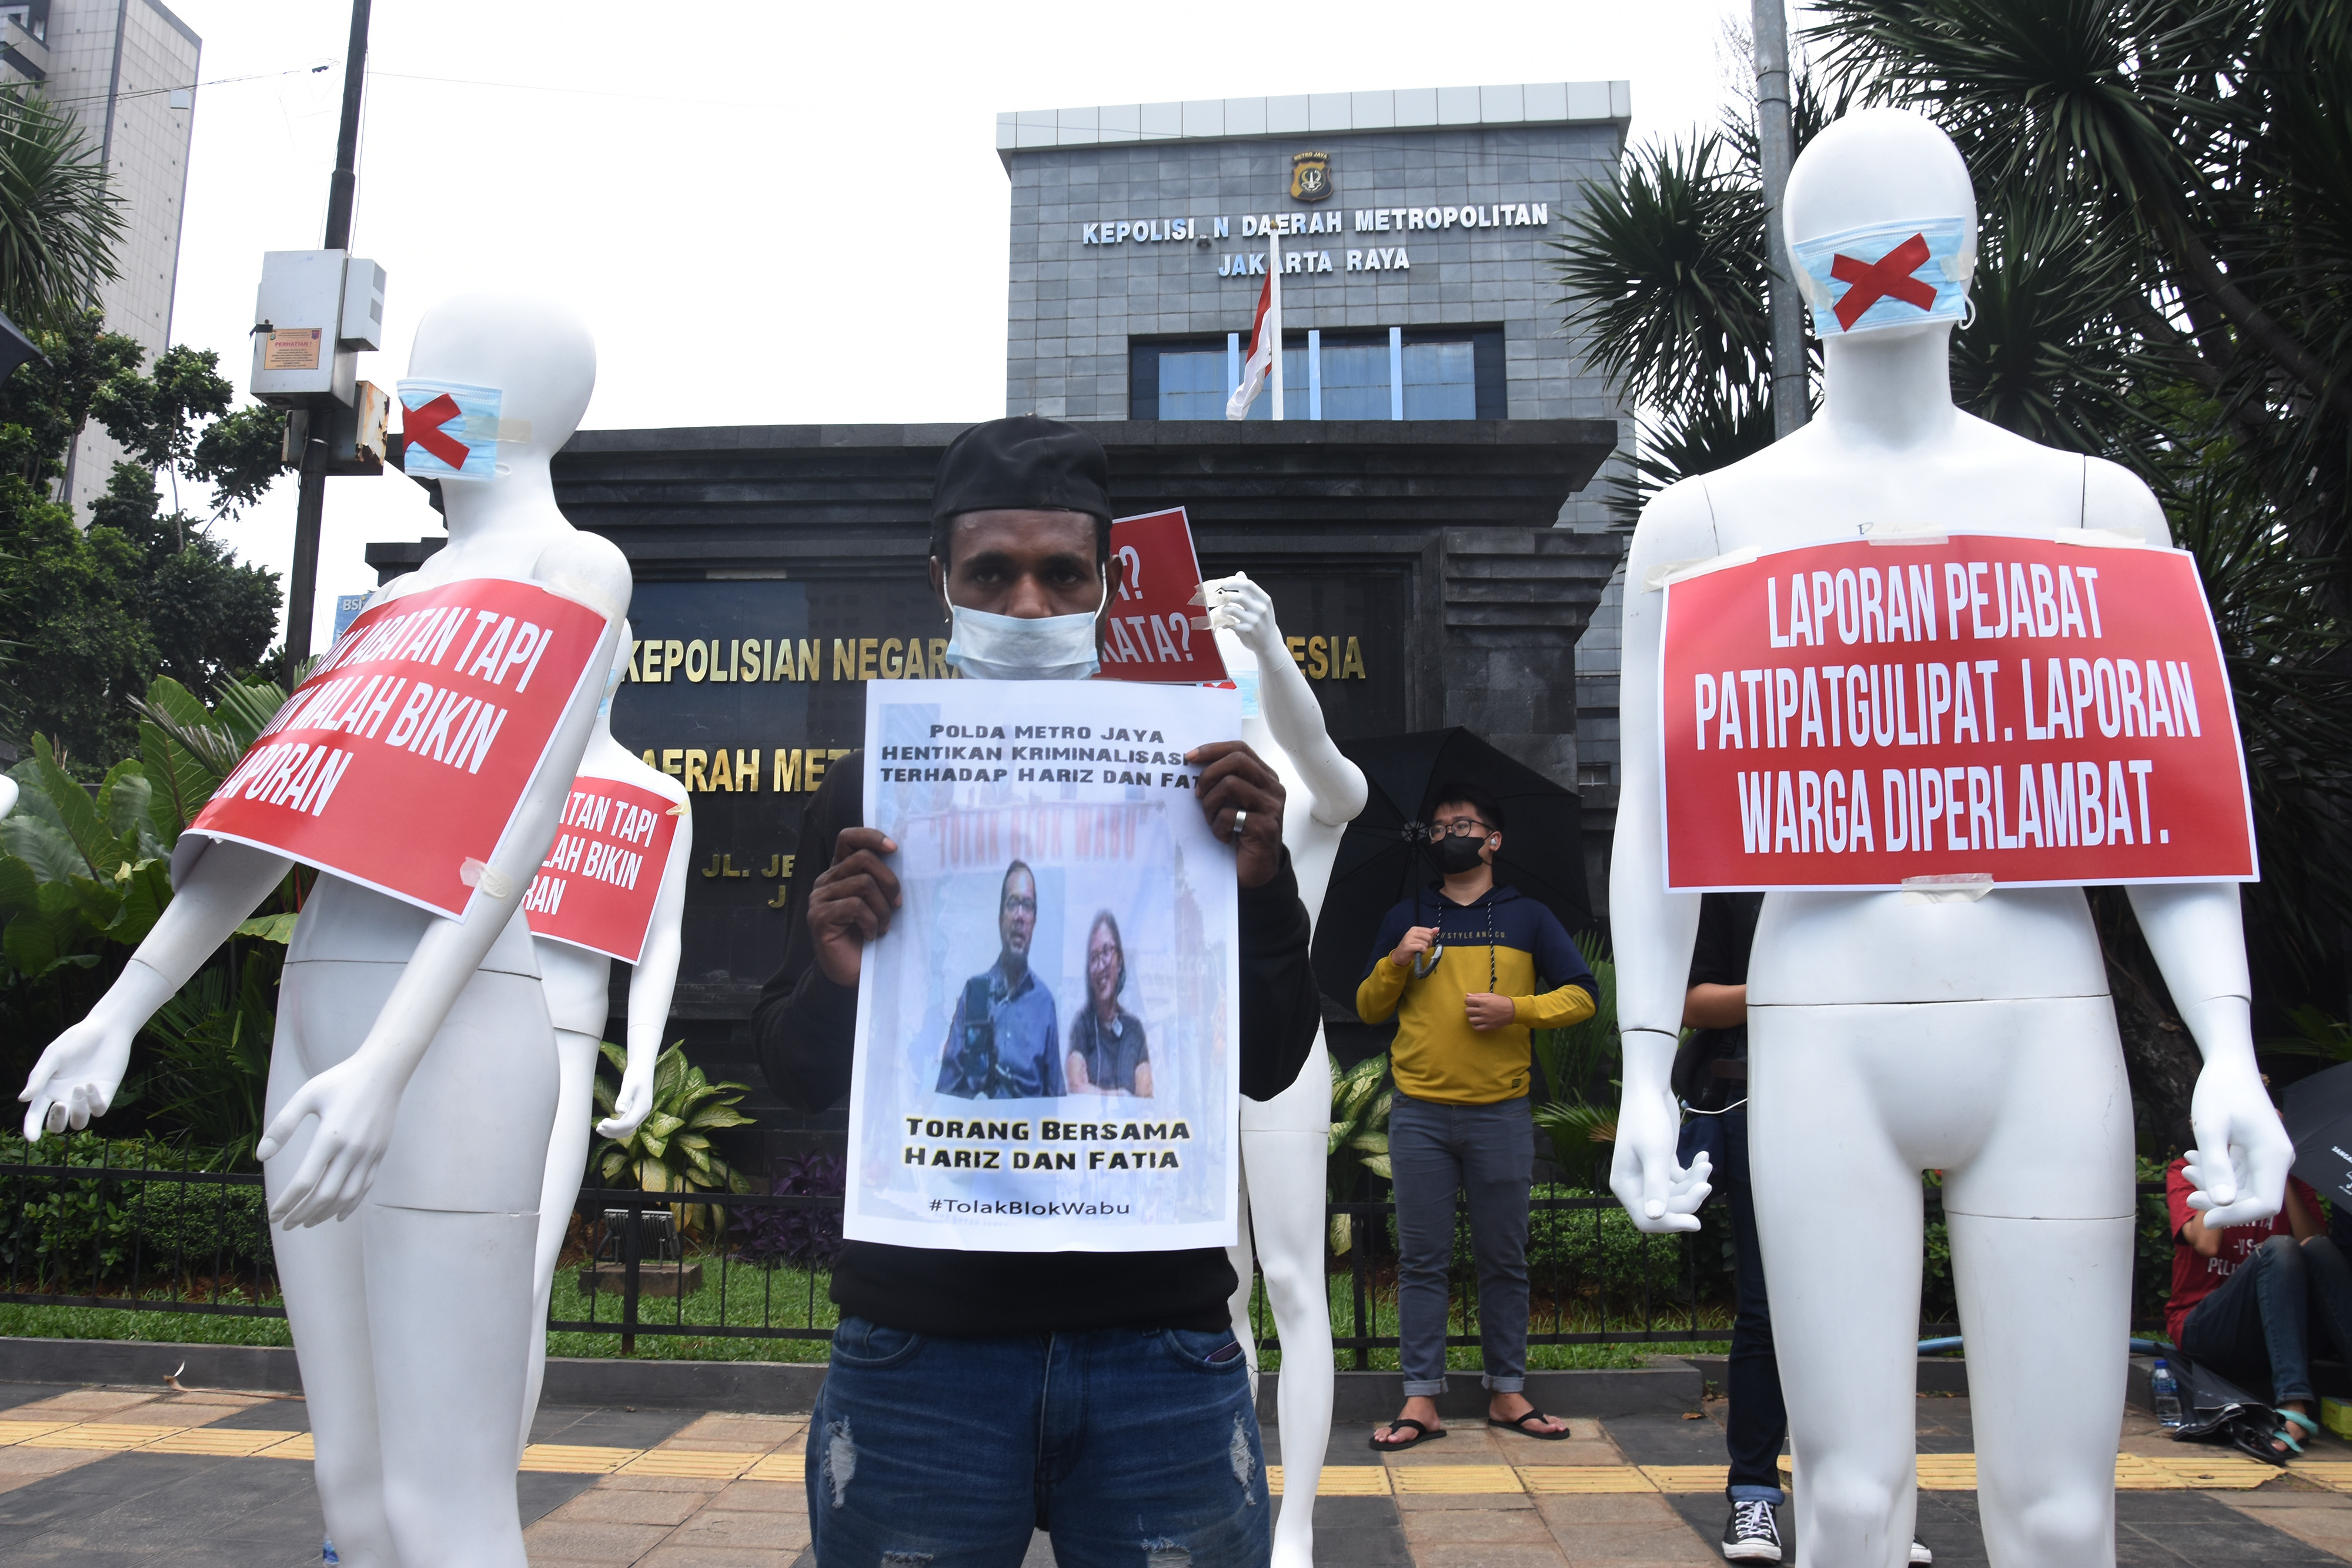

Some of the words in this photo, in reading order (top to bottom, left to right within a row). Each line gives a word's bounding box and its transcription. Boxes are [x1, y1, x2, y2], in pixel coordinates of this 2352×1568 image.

[1242, 211, 1342, 236] DAERAH
[1355, 202, 1548, 232] METROPOLITAN
[1347, 248, 1410, 272] RAYA
[343, 599, 362, 611] BSI
[1767, 563, 1937, 649] LAPORAN
[1944, 561, 2103, 640] PEJABAT
[335, 607, 472, 670] JABATAN
[453, 610, 553, 694] TAPI
[621, 638, 820, 683] KEPOLISIAN
[1694, 659, 2013, 751] PATIPATGULIPAT.
[2020, 657, 2201, 742] LAPORAN
[286, 674, 407, 739] MALAH
[384, 681, 509, 775] BIKIN
[930, 724, 1005, 739] POLDA
[1014, 726, 1091, 740] METRO
[1101, 727, 1164, 744] JAYA
[882, 745, 1002, 761] HENTIKAN
[208, 742, 354, 817] LAPORAN
[881, 767, 1008, 783] TERHADAP
[1018, 768, 1094, 784] HARIZ
[1103, 770, 1152, 787] DAN
[610, 800, 658, 847] TAPI
[1737, 768, 1875, 854] WARGA
[1883, 759, 2170, 852] DIPERLAMBAT.
[582, 841, 643, 890] BIKIN
[701, 854, 749, 877] JL.
[906, 1118, 1029, 1141] TORANG
[1041, 1121, 1190, 1140] BERSAMA
[904, 1147, 1000, 1169] HARIZ
[1013, 1151, 1076, 1169] DAN
[1089, 1151, 1180, 1169] FATIA
[929, 1199, 1130, 1216] #TolakBlokWabu
